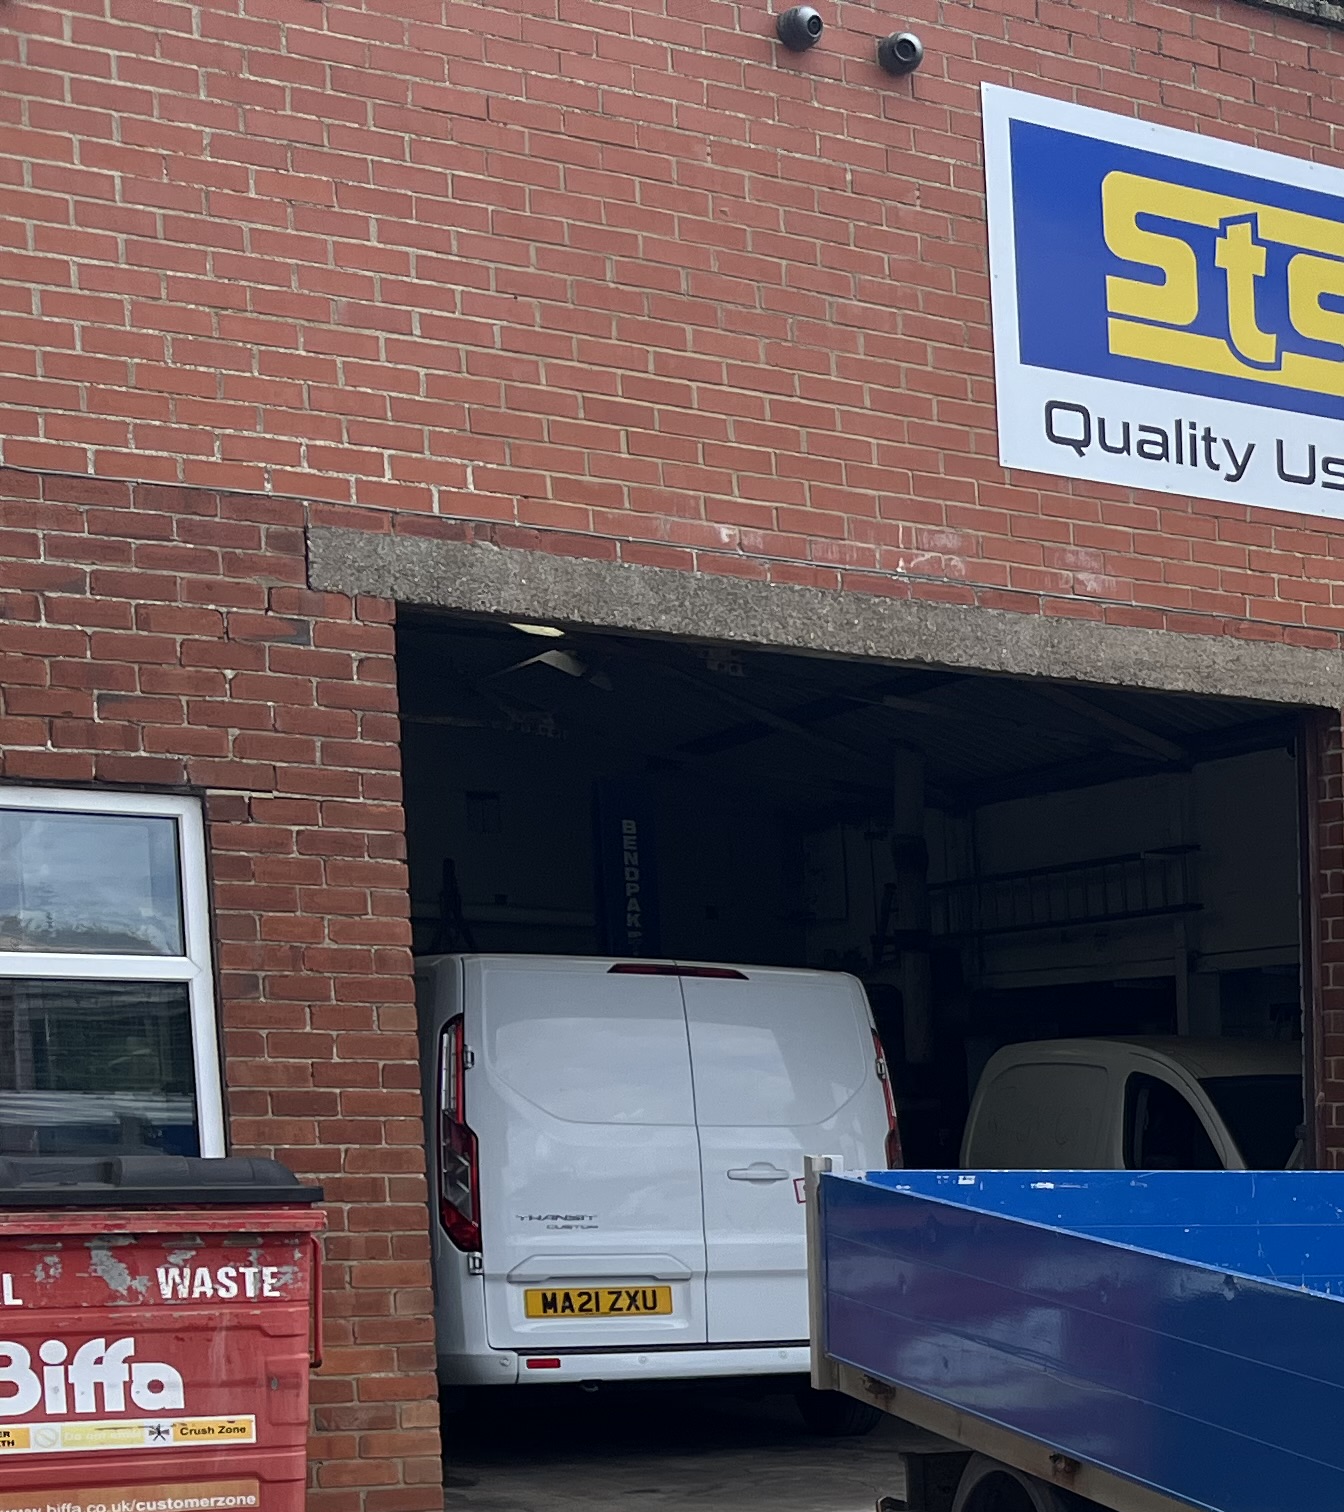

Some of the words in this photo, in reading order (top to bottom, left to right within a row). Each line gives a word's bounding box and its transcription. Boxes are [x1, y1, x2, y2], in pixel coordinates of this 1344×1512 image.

[1044, 399, 1256, 482] Quality
[156, 1266, 281, 1299] WASTE
[541, 1291, 600, 1314] MA21
[607, 1289, 658, 1312] ZXU
[0, 1337, 185, 1417] Biffa
[180, 1426, 215, 1437] Crush
[218, 1424, 247, 1435] Zone
